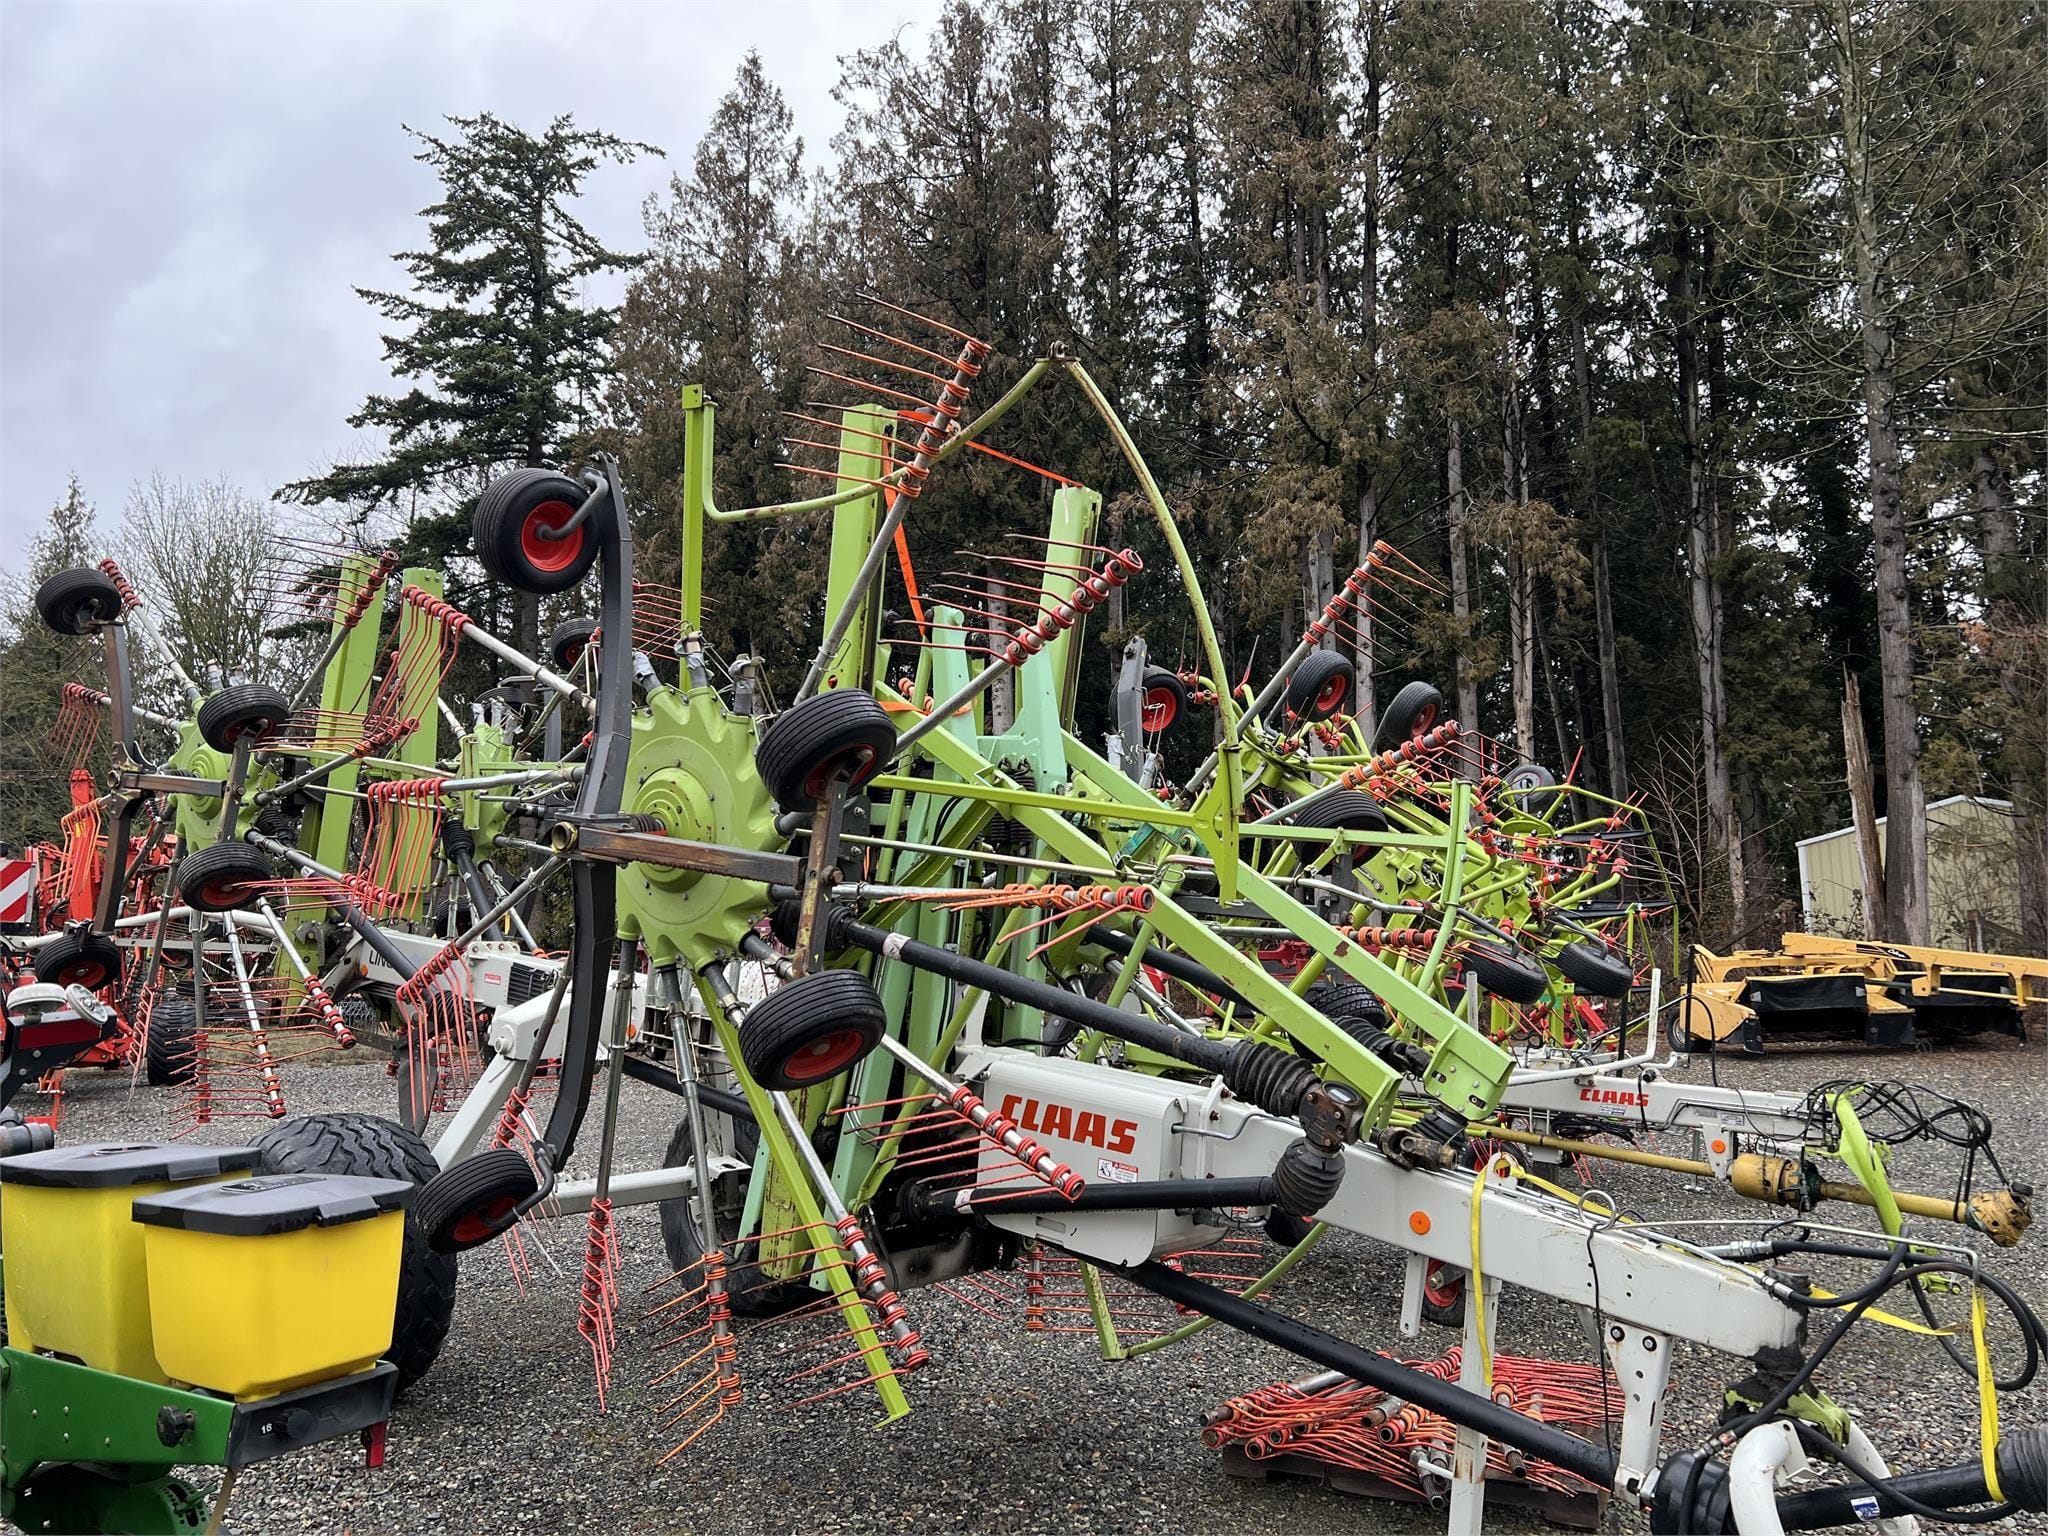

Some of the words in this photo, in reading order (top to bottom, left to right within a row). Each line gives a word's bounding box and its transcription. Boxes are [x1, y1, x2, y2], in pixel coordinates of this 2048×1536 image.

[1580, 1088, 1649, 1107] CLAAS
[1000, 1094, 1138, 1154] CLAAS
[260, 1423, 273, 1434] 16
